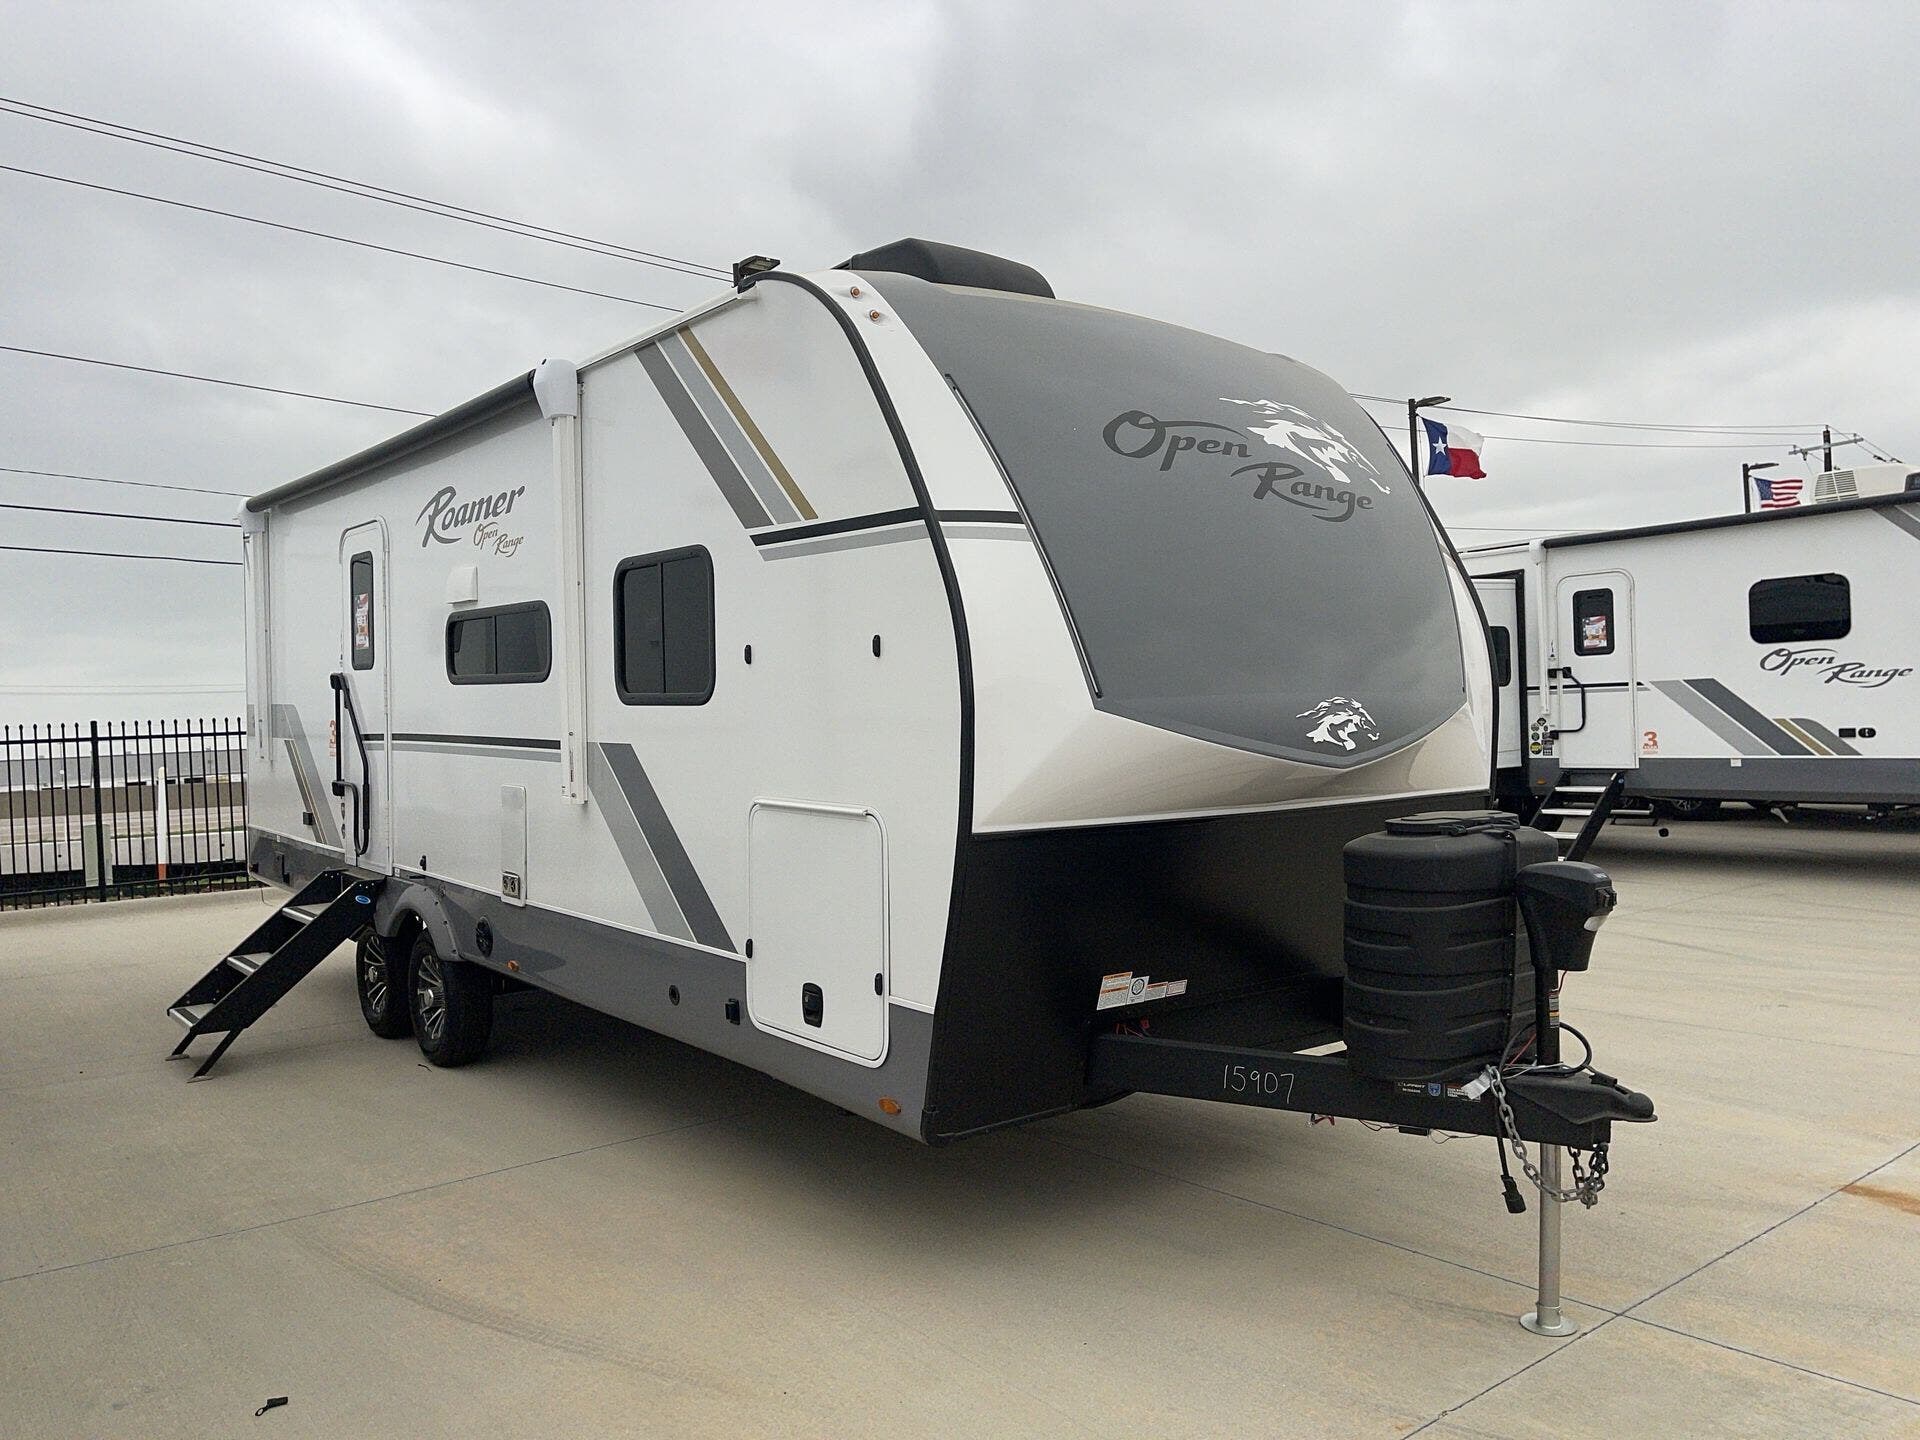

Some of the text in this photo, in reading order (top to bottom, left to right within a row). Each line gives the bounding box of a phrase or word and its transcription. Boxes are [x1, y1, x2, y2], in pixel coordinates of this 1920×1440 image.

[1102, 410, 1252, 472] Open
[1230, 461, 1374, 523] Range
[415, 485, 525, 548] Roamer
[473, 521, 498, 550] Open
[493, 533, 524, 558] Range
[1759, 648, 1839, 676] Open
[1816, 662, 1914, 689] Range
[1643, 731, 1659, 747] 3
[1223, 1064, 1295, 1105] 15907
